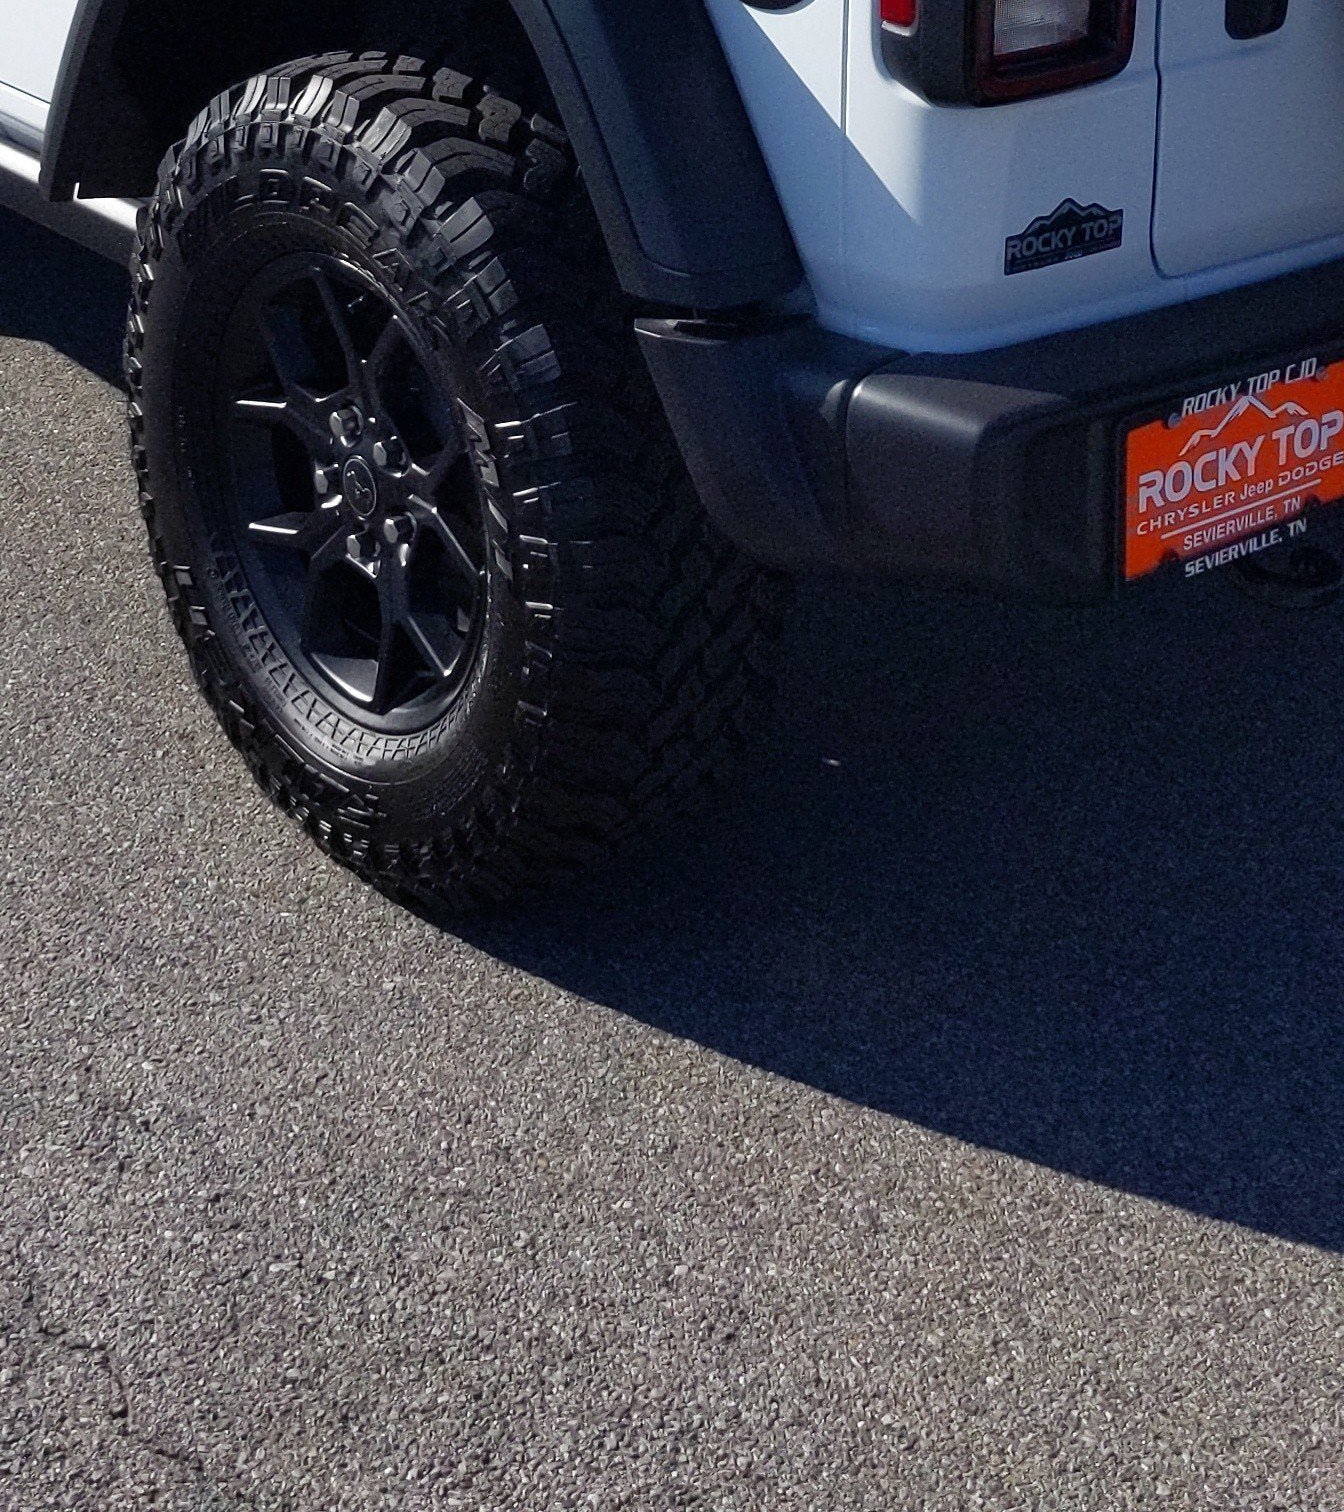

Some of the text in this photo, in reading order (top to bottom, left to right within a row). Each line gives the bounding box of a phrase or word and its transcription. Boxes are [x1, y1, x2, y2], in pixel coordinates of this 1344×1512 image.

[1006, 214, 1123, 261] ROCKY TOP
[1181, 357, 1318, 418] ROCKY TOP CJD
[1138, 409, 1344, 514] ROCKY TOP
[1136, 450, 1344, 536] CHRYSLER Jeep DODGE
[1183, 496, 1302, 551] SEVIERVILLE, TN
[1288, 517, 1307, 538] TN
